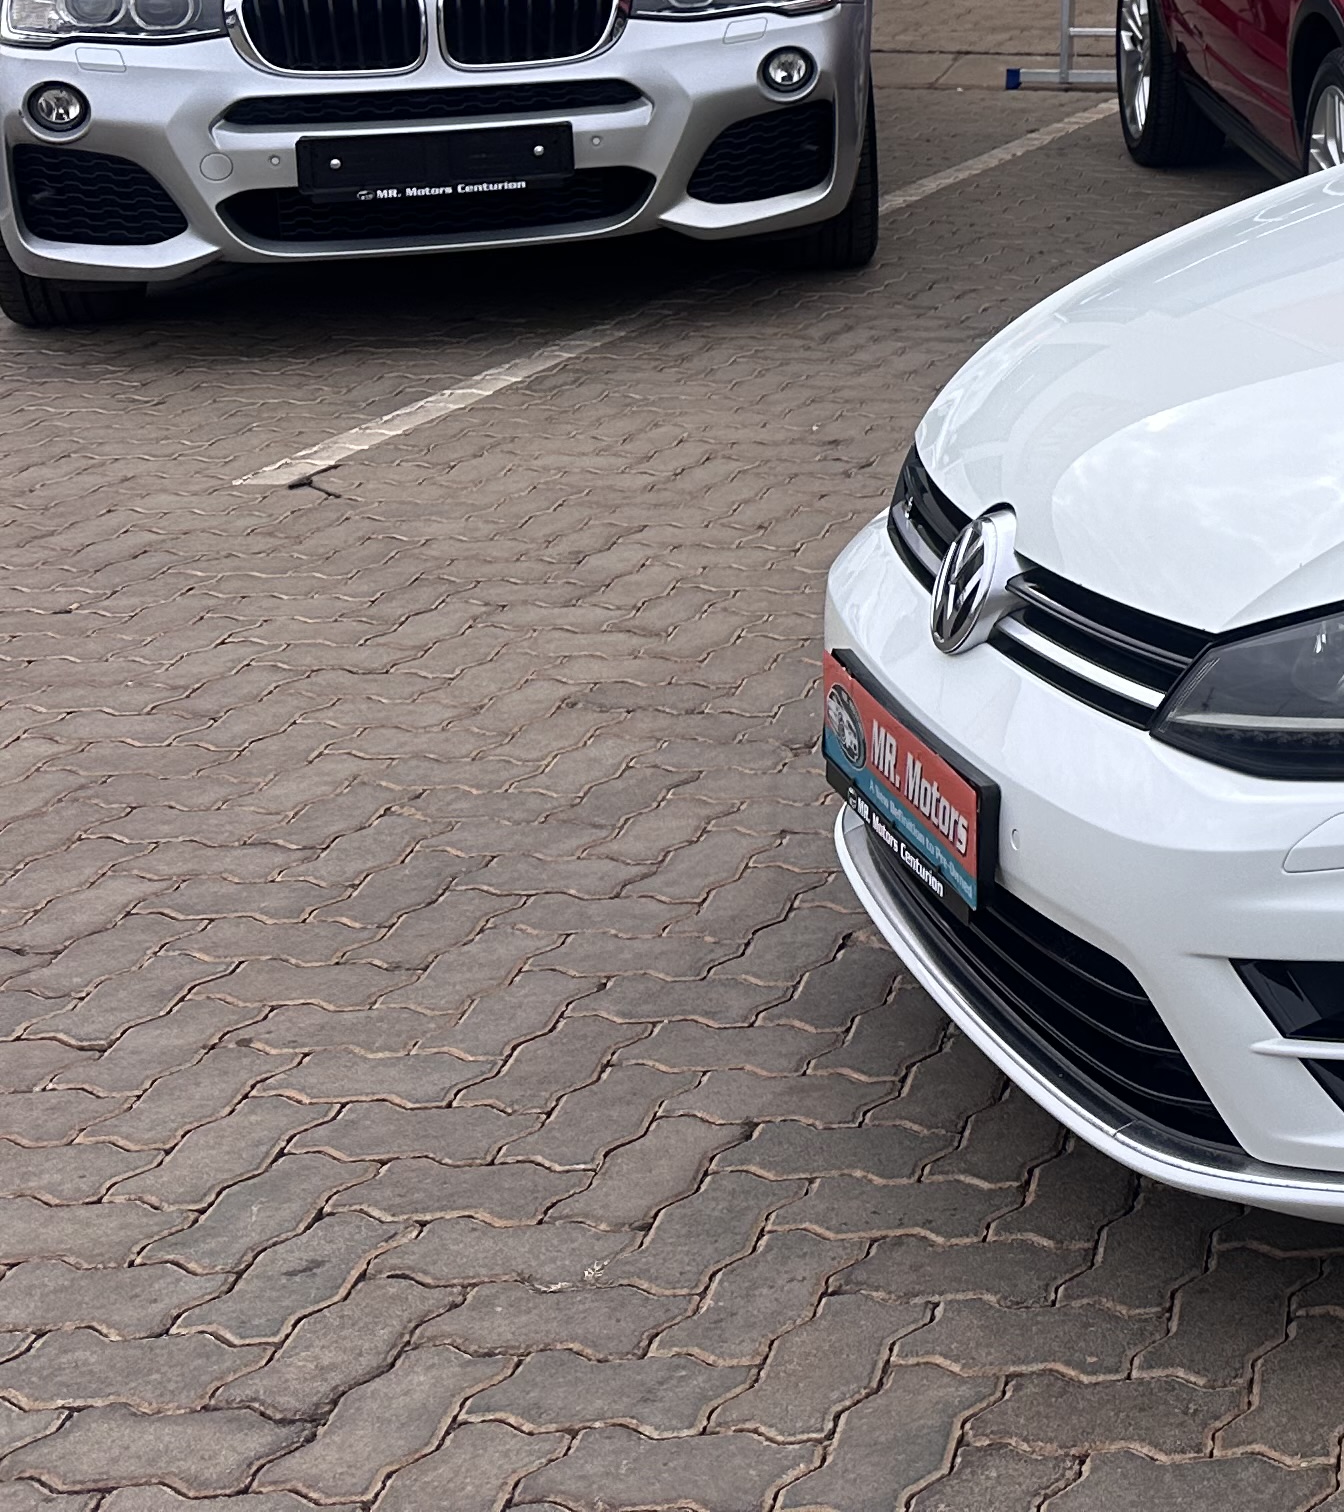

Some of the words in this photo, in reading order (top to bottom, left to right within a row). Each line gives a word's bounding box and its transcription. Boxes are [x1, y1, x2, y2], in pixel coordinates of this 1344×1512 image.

[377, 189, 401, 199] MR.
[405, 185, 453, 197] Motors
[457, 181, 527, 194] Centurion
[871, 719, 901, 790] MR.
[904, 751, 969, 856] Motors
[857, 796, 871, 824] MR.
[872, 812, 899, 853] Motors
[900, 842, 944, 898] Centurion
